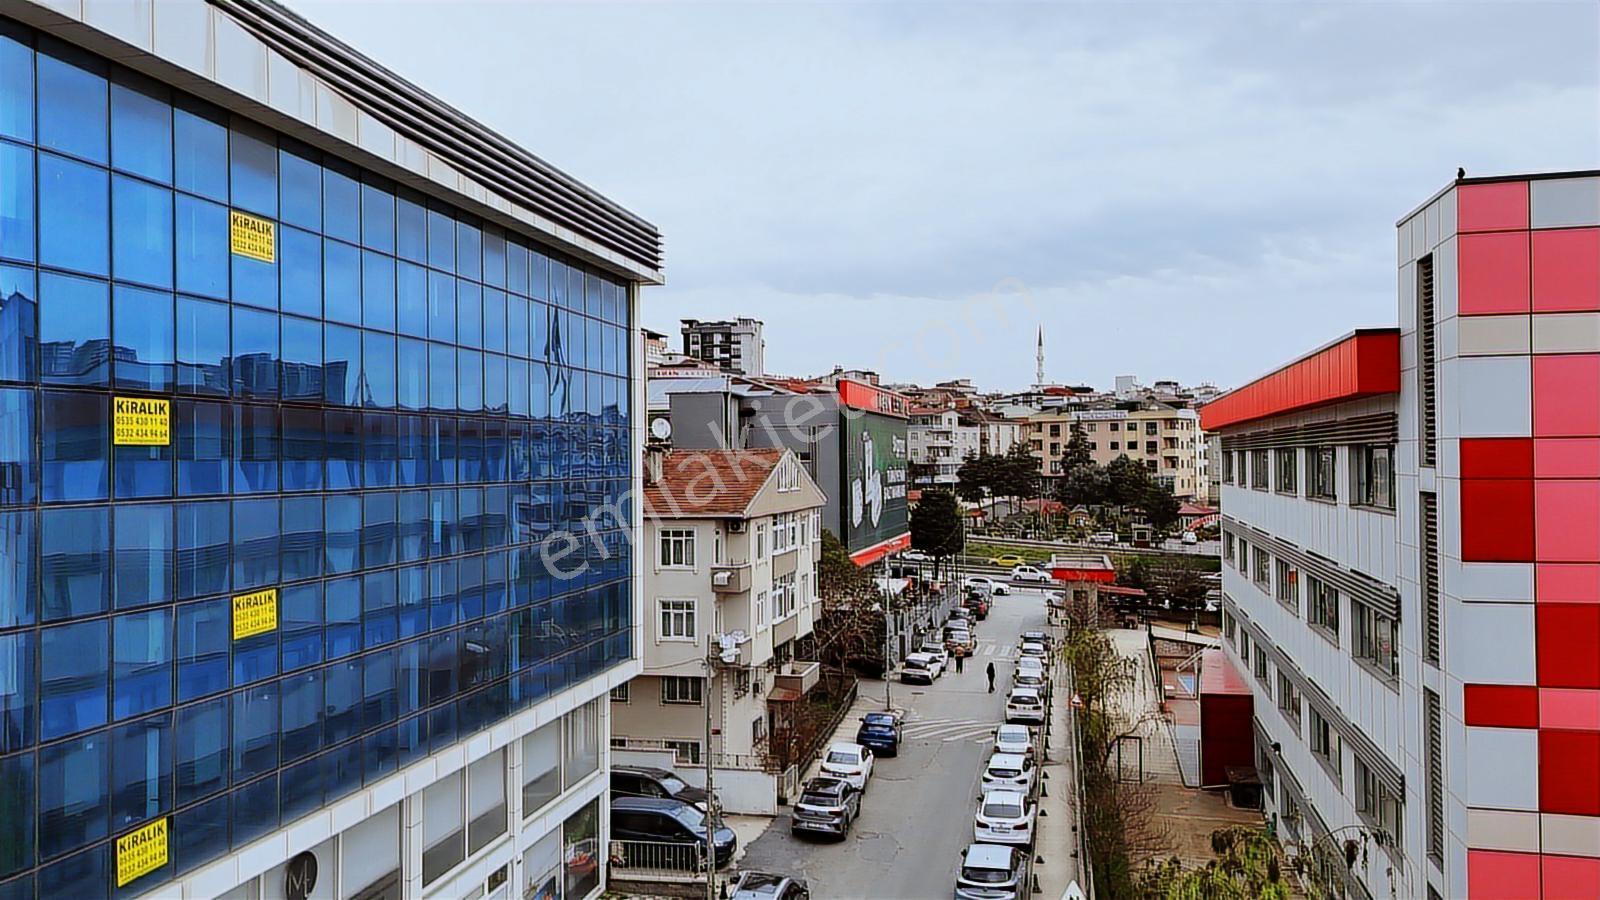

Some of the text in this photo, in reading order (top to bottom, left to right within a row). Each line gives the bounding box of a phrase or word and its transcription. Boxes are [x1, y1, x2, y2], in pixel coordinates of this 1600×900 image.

[232, 213, 273, 238] KİRALIK
[116, 400, 166, 414] KİRALIK
[235, 591, 274, 612] KİRALIK
[119, 820, 165, 855] KİRALIK
